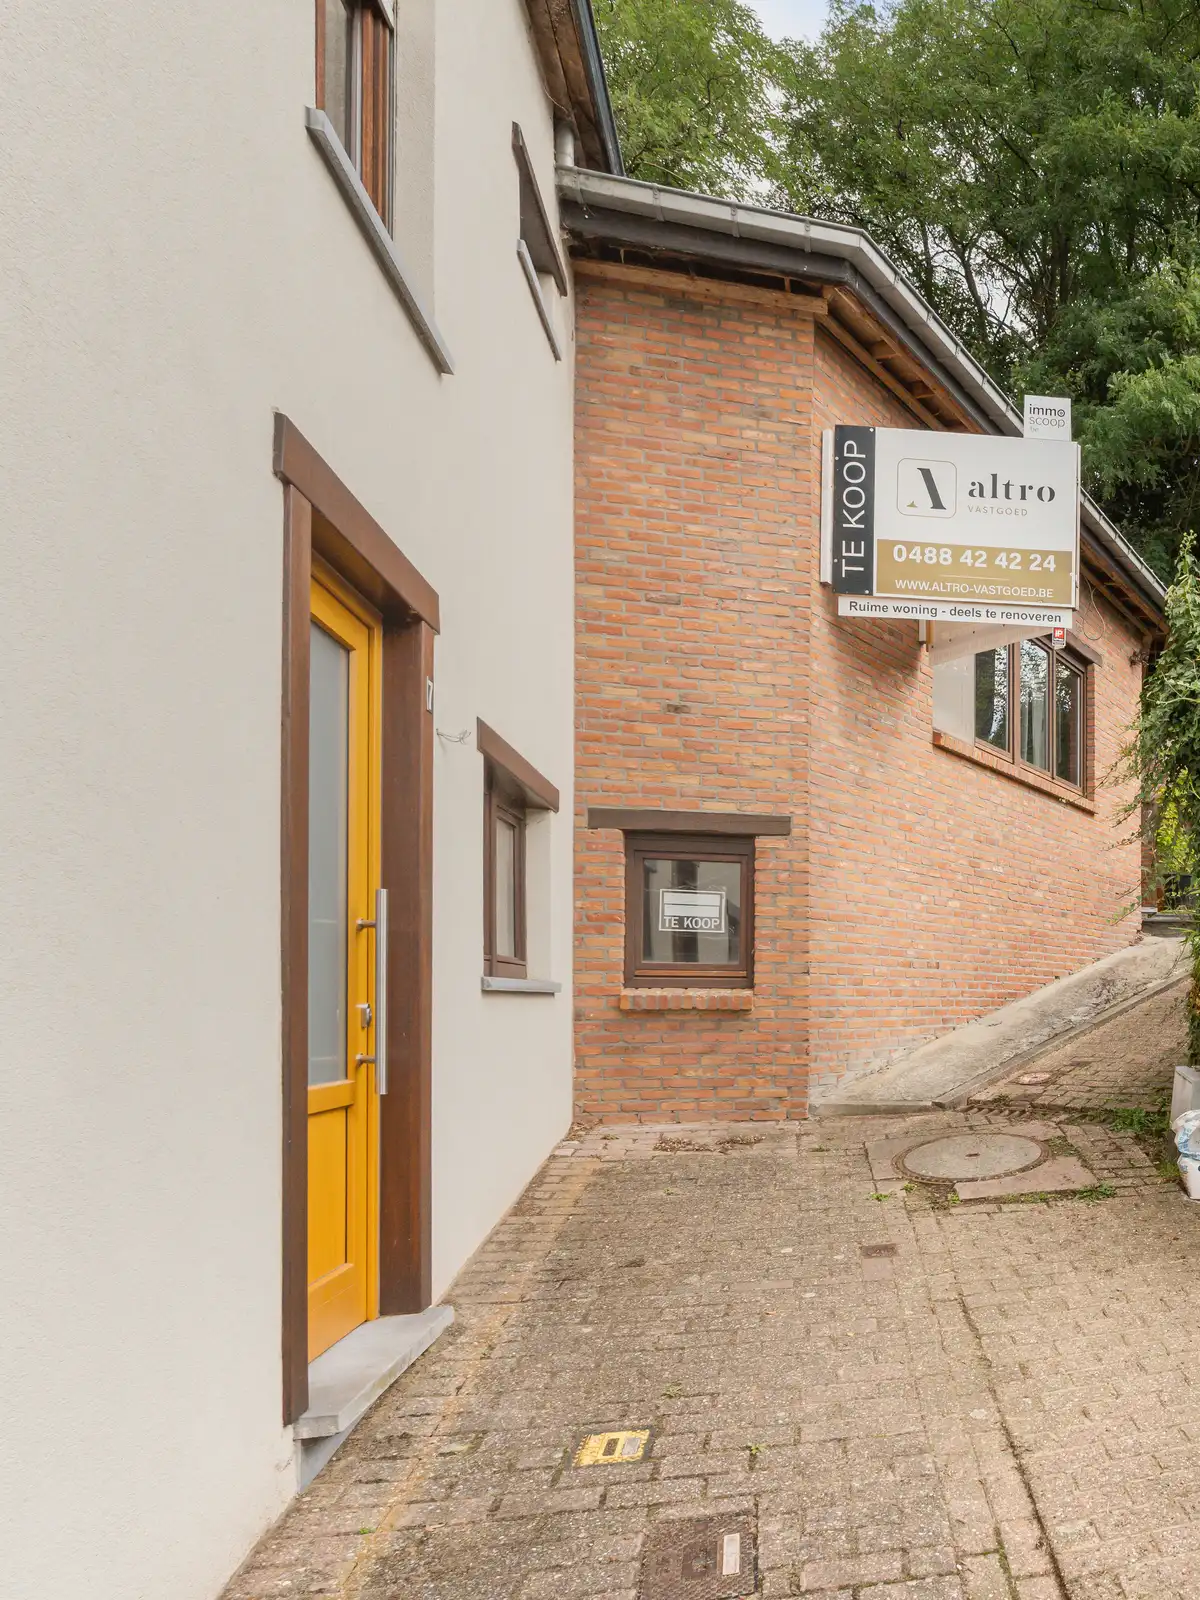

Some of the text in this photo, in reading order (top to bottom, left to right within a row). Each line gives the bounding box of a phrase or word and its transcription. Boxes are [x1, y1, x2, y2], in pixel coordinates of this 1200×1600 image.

[1029, 416, 1066, 428] scoop
[968, 473, 1056, 503] altro
[842, 440, 866, 578] TE KOOP
[967, 504, 1028, 517] VASTGOED
[893, 544, 1057, 572] 0488 42 42 24
[895, 579, 1054, 598] WWW.ALTRO-VASTGOED.BE
[849, 600, 889, 613] Ruime
[892, 604, 938, 617] woning
[949, 607, 982, 618] deels
[985, 609, 997, 619] te
[1000, 610, 1062, 623] renoveren
[663, 916, 720, 929] TE KOOP
